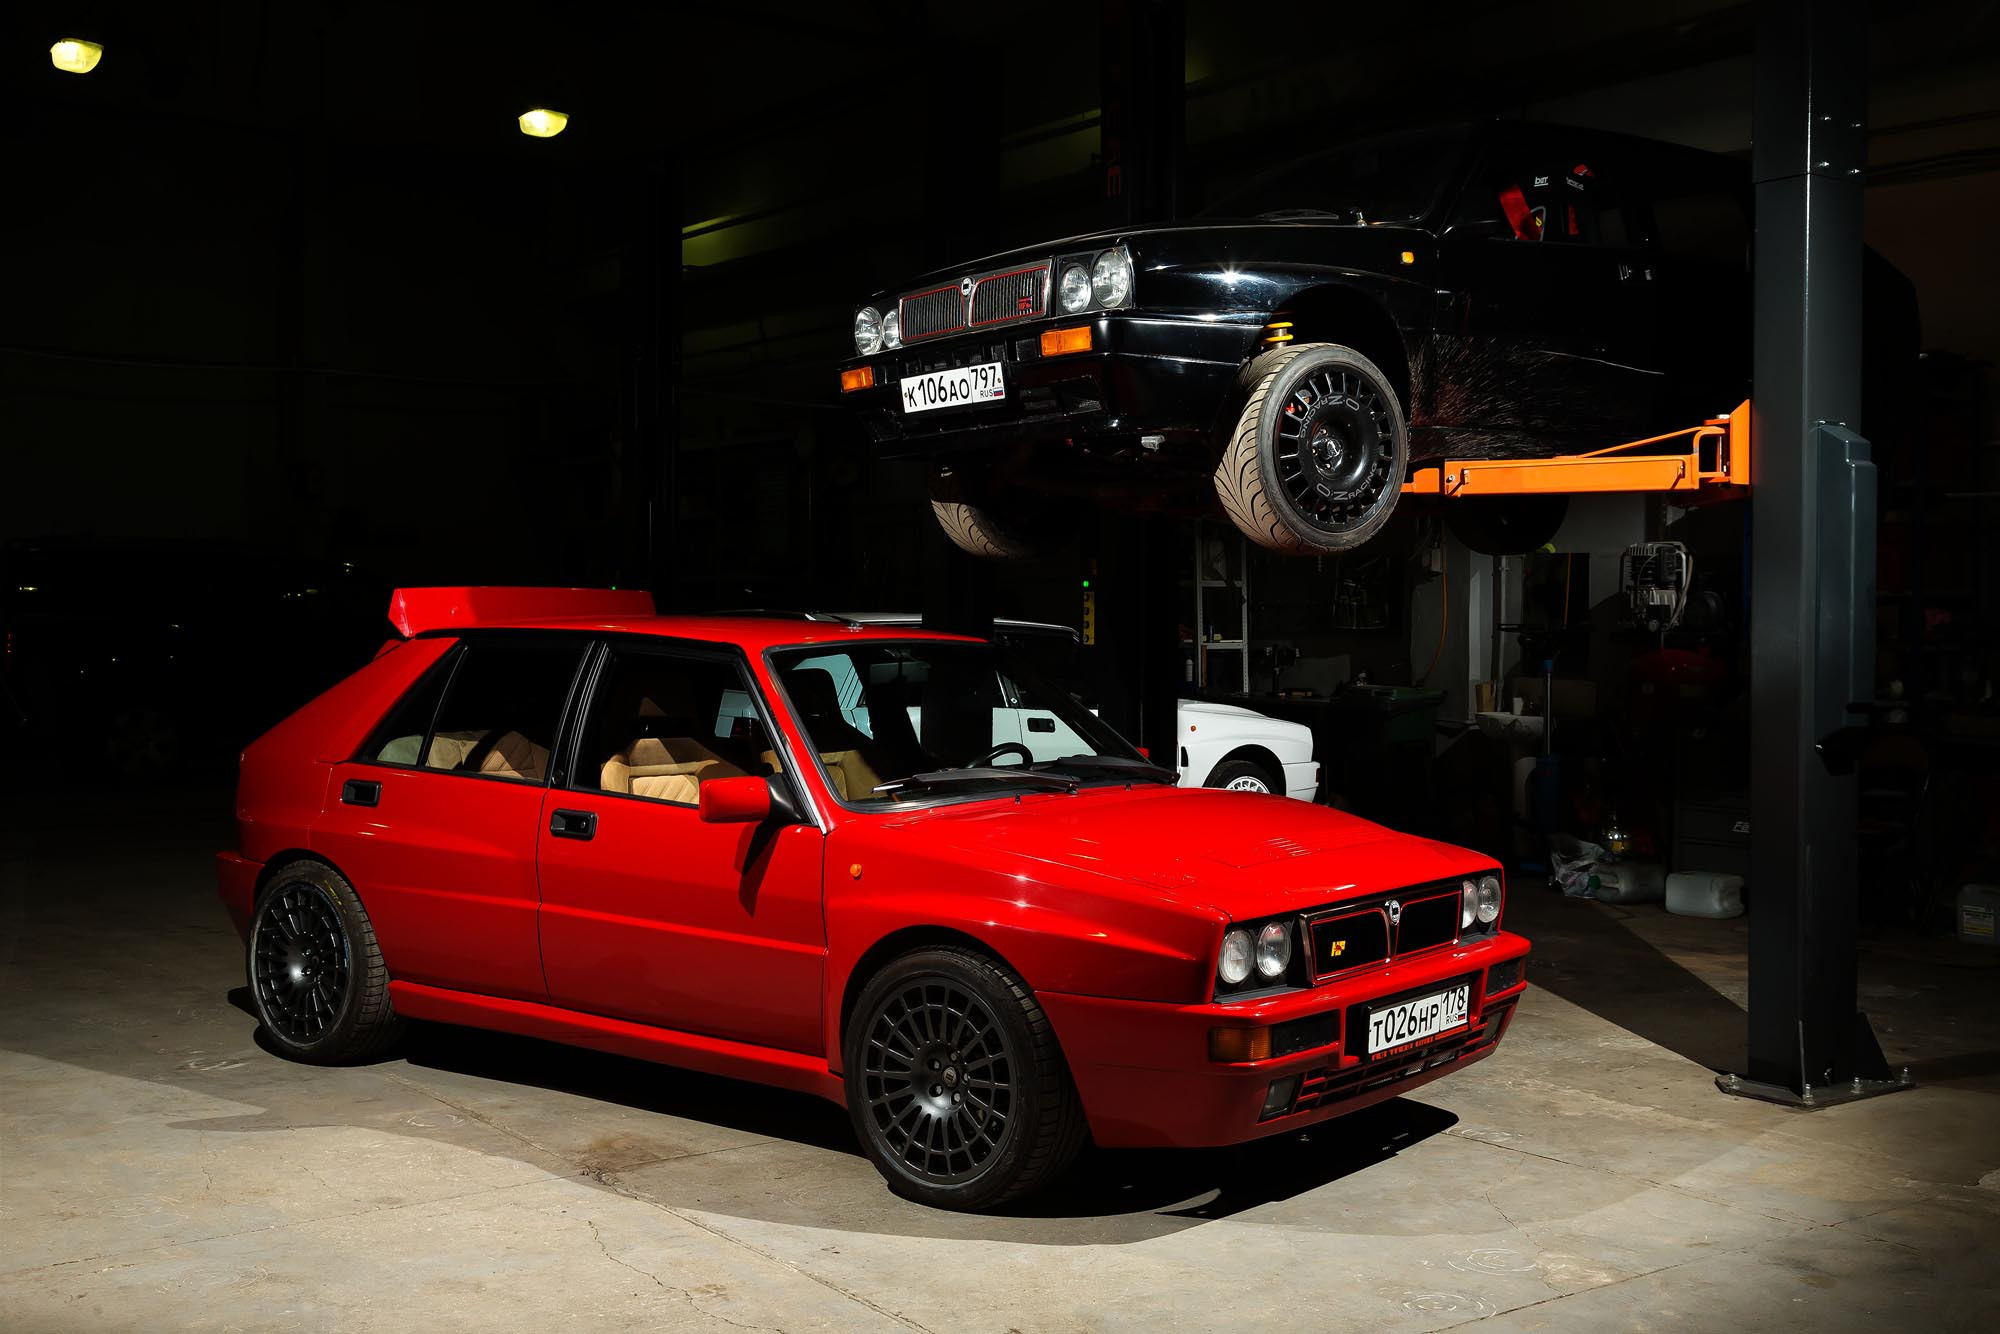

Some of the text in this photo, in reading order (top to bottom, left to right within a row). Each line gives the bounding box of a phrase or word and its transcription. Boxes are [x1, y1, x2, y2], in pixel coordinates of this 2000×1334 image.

[971, 365, 996, 390] 797
[980, 389, 993, 398] RUS
[1347, 462, 1378, 500] RACING
[1442, 987, 1466, 1015] 178
[1445, 1013, 1458, 1024] RUS
